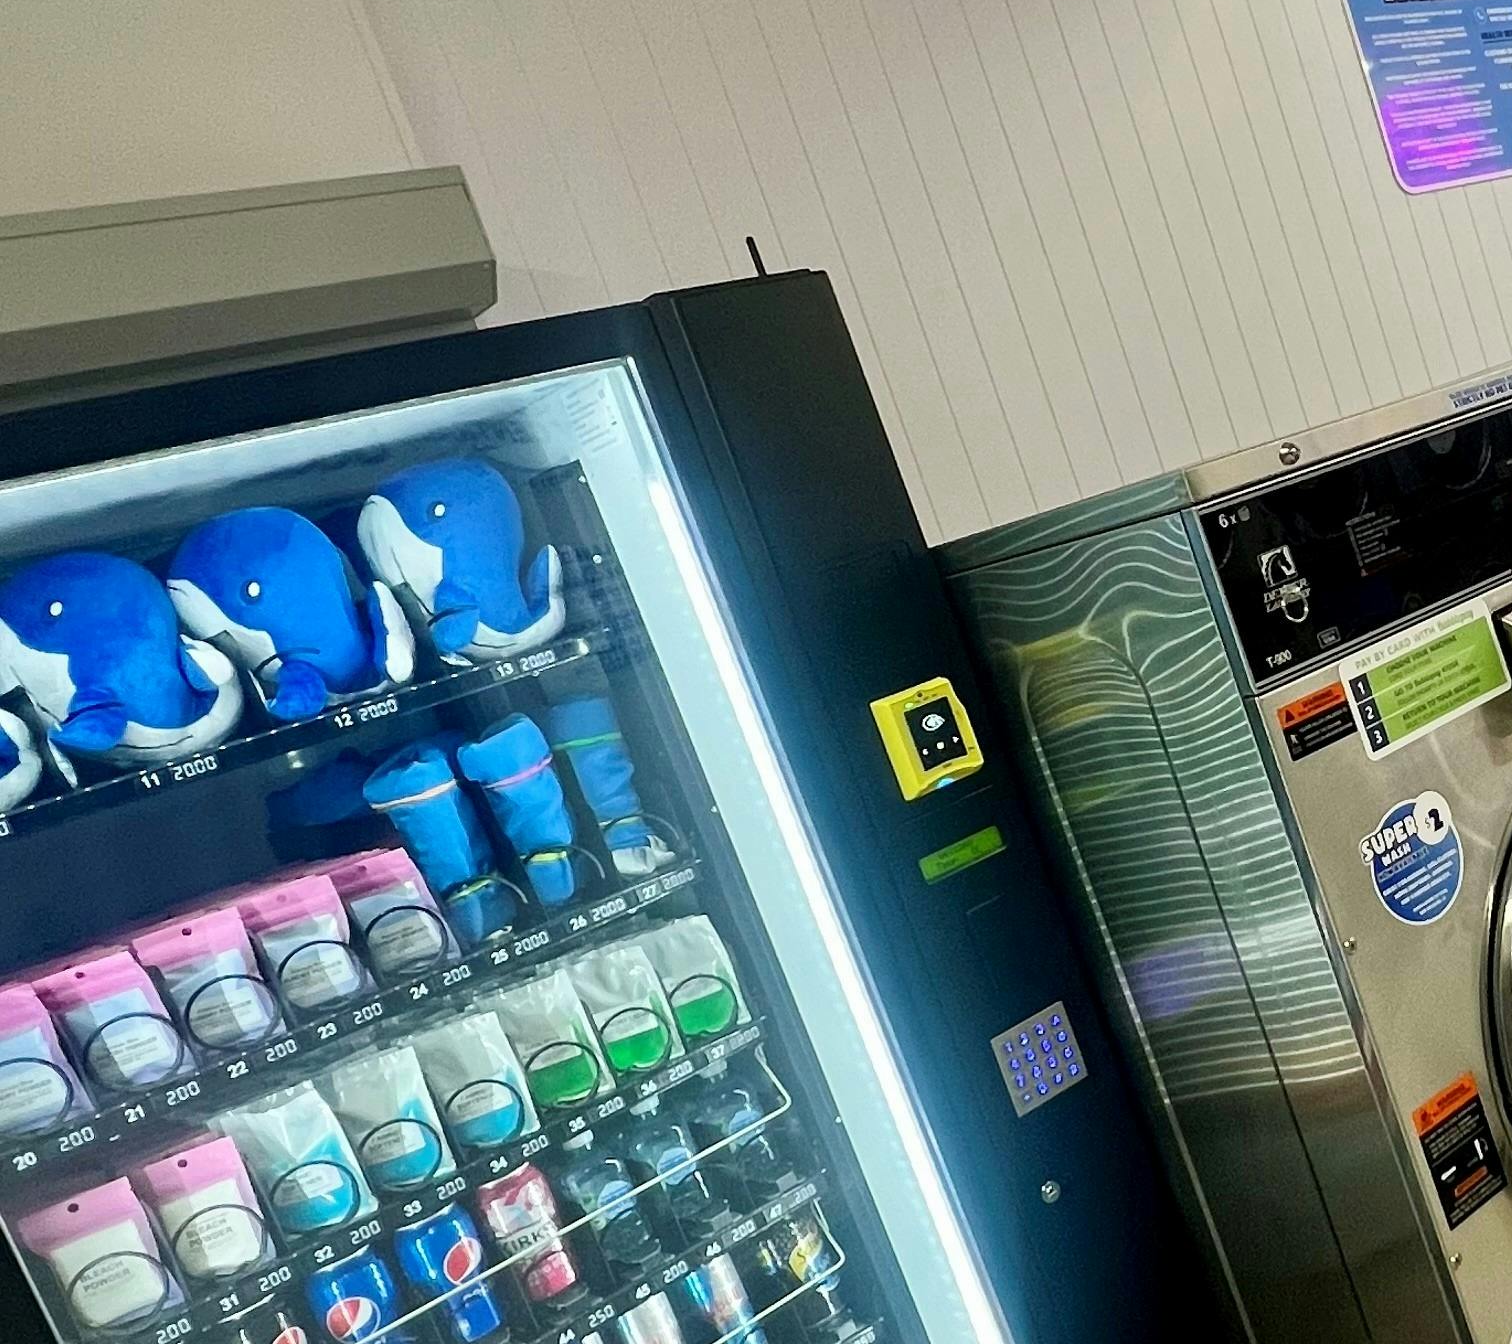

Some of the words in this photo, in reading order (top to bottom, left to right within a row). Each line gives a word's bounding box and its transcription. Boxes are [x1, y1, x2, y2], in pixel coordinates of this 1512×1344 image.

[1218, 513, 1229, 529] 6
[1387, 636, 1412, 656] CARD
[1357, 681, 1365, 696] 1
[333, 711, 354, 729] 12
[1365, 706, 1375, 721] 2
[1373, 730, 1383, 745] 3
[140, 771, 161, 790] 11
[1361, 814, 1418, 863] SUPER
[1381, 842, 1412, 867] WASH
[569, 915, 588, 931] 26
[489, 947, 510, 965] 25
[408, 983, 429, 1001] 24
[316, 1022, 337, 1040] 23
[226, 1060, 250, 1079] 22
[640, 1079, 658, 1096] 36
[124, 1104, 146, 1123] 21
[568, 1117, 587, 1133] 35
[12, 1151, 38, 1172] 20
[488, 1156, 508, 1174] 34
[403, 1199, 423, 1218] 33
[314, 1244, 336, 1263] 32
[705, 1241, 722, 1258] 46
[83, 1267, 131, 1294] POWDER
[635, 1284, 652, 1300] 45
[218, 1293, 240, 1312] 31
